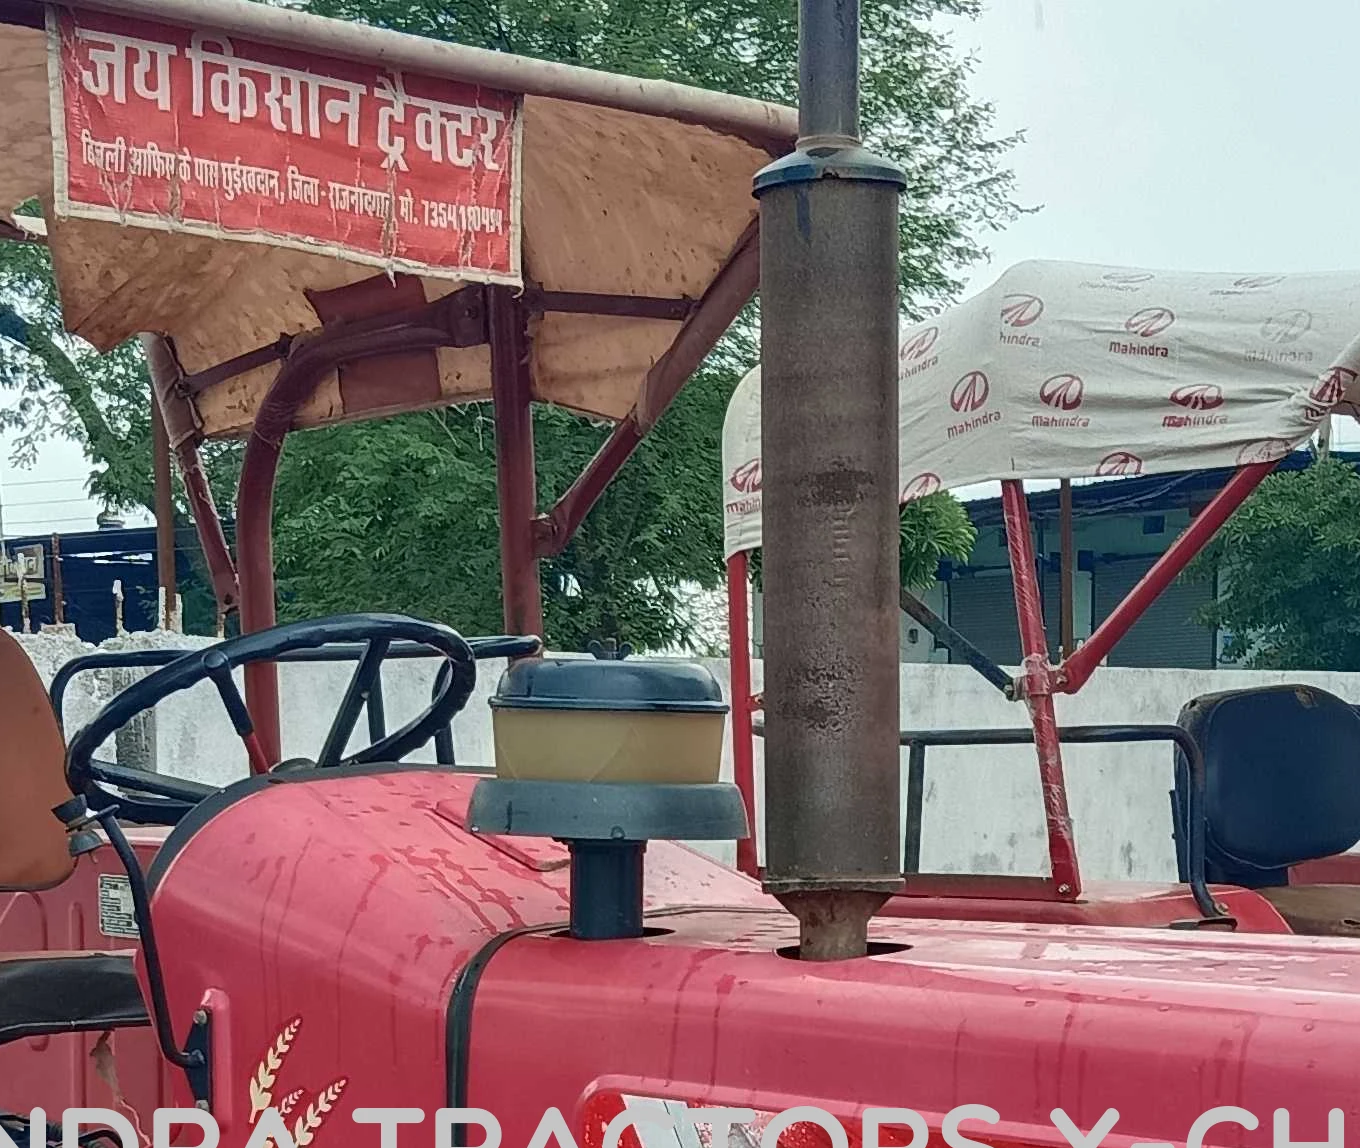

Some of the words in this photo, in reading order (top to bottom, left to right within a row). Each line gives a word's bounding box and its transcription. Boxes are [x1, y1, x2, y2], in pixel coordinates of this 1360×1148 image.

[74, 28, 177, 111] जय
[185, 31, 366, 147] किसान
[373, 68, 505, 172] ट्रैक्टर
[286, 165, 319, 206] जिला
